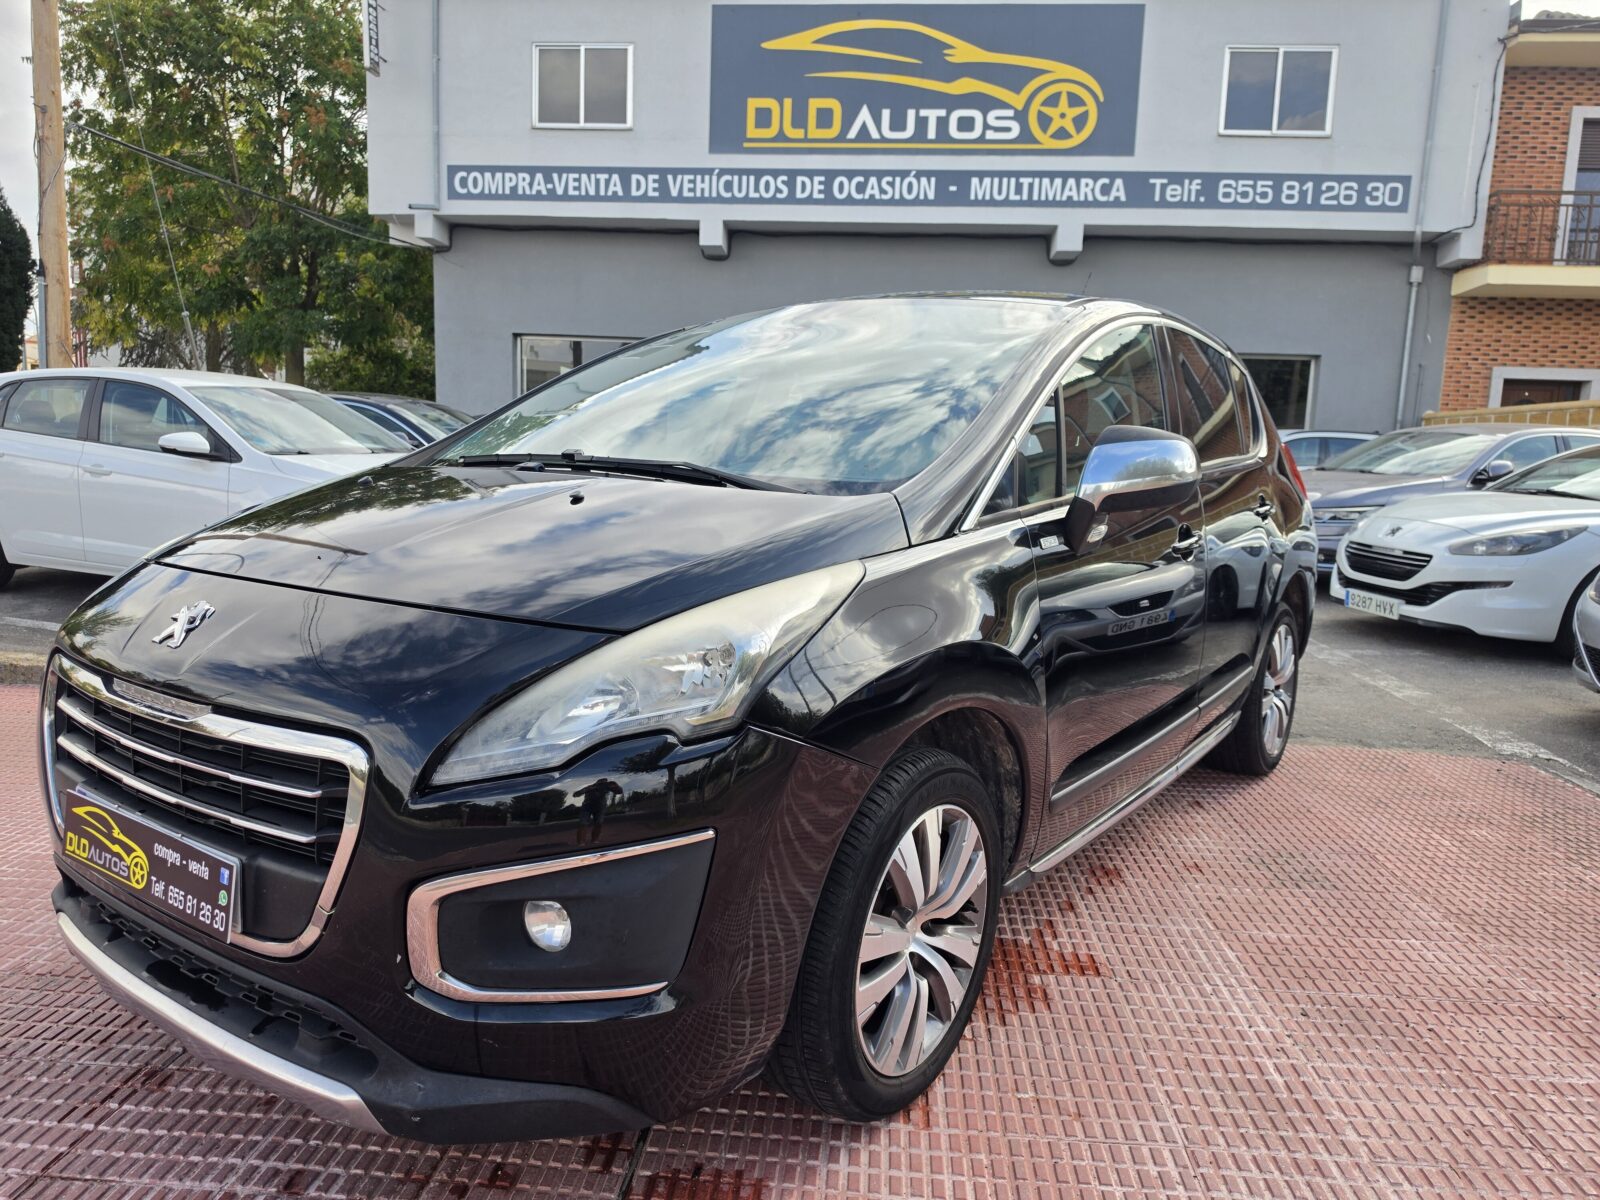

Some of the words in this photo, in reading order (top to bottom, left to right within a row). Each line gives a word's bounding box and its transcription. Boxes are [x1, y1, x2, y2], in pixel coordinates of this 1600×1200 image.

[745, 97, 842, 139] DLD
[846, 103, 1021, 140] AUTOS
[453, 171, 624, 197] COMPRA-VENTA
[630, 174, 660, 197] DE
[667, 169, 789, 198] VEHÍCULOS
[795, 175, 825, 199] DE
[832, 171, 936, 200] OCASIÓN
[969, 176, 1127, 202] MULTIMARCA
[1149, 178, 1205, 202] Telf.
[1217, 179, 1274, 204] 655
[1281, 181, 1313, 205] 81
[1320, 181, 1359, 206] 26
[1365, 182, 1404, 207] 30
[1350, 592, 1373, 610] 9287
[1375, 598, 1395, 617] HVX
[66, 831, 89, 858] DLD
[88, 845, 129, 877] AUTOS
[153, 842, 181, 867] compra
[188, 858, 209, 880] venta
[150, 876, 166, 900] Telf.
[168, 885, 185, 909] 655
[185, 894, 198, 916] 81
[199, 902, 212, 924] 26
[213, 909, 226, 932] 30
